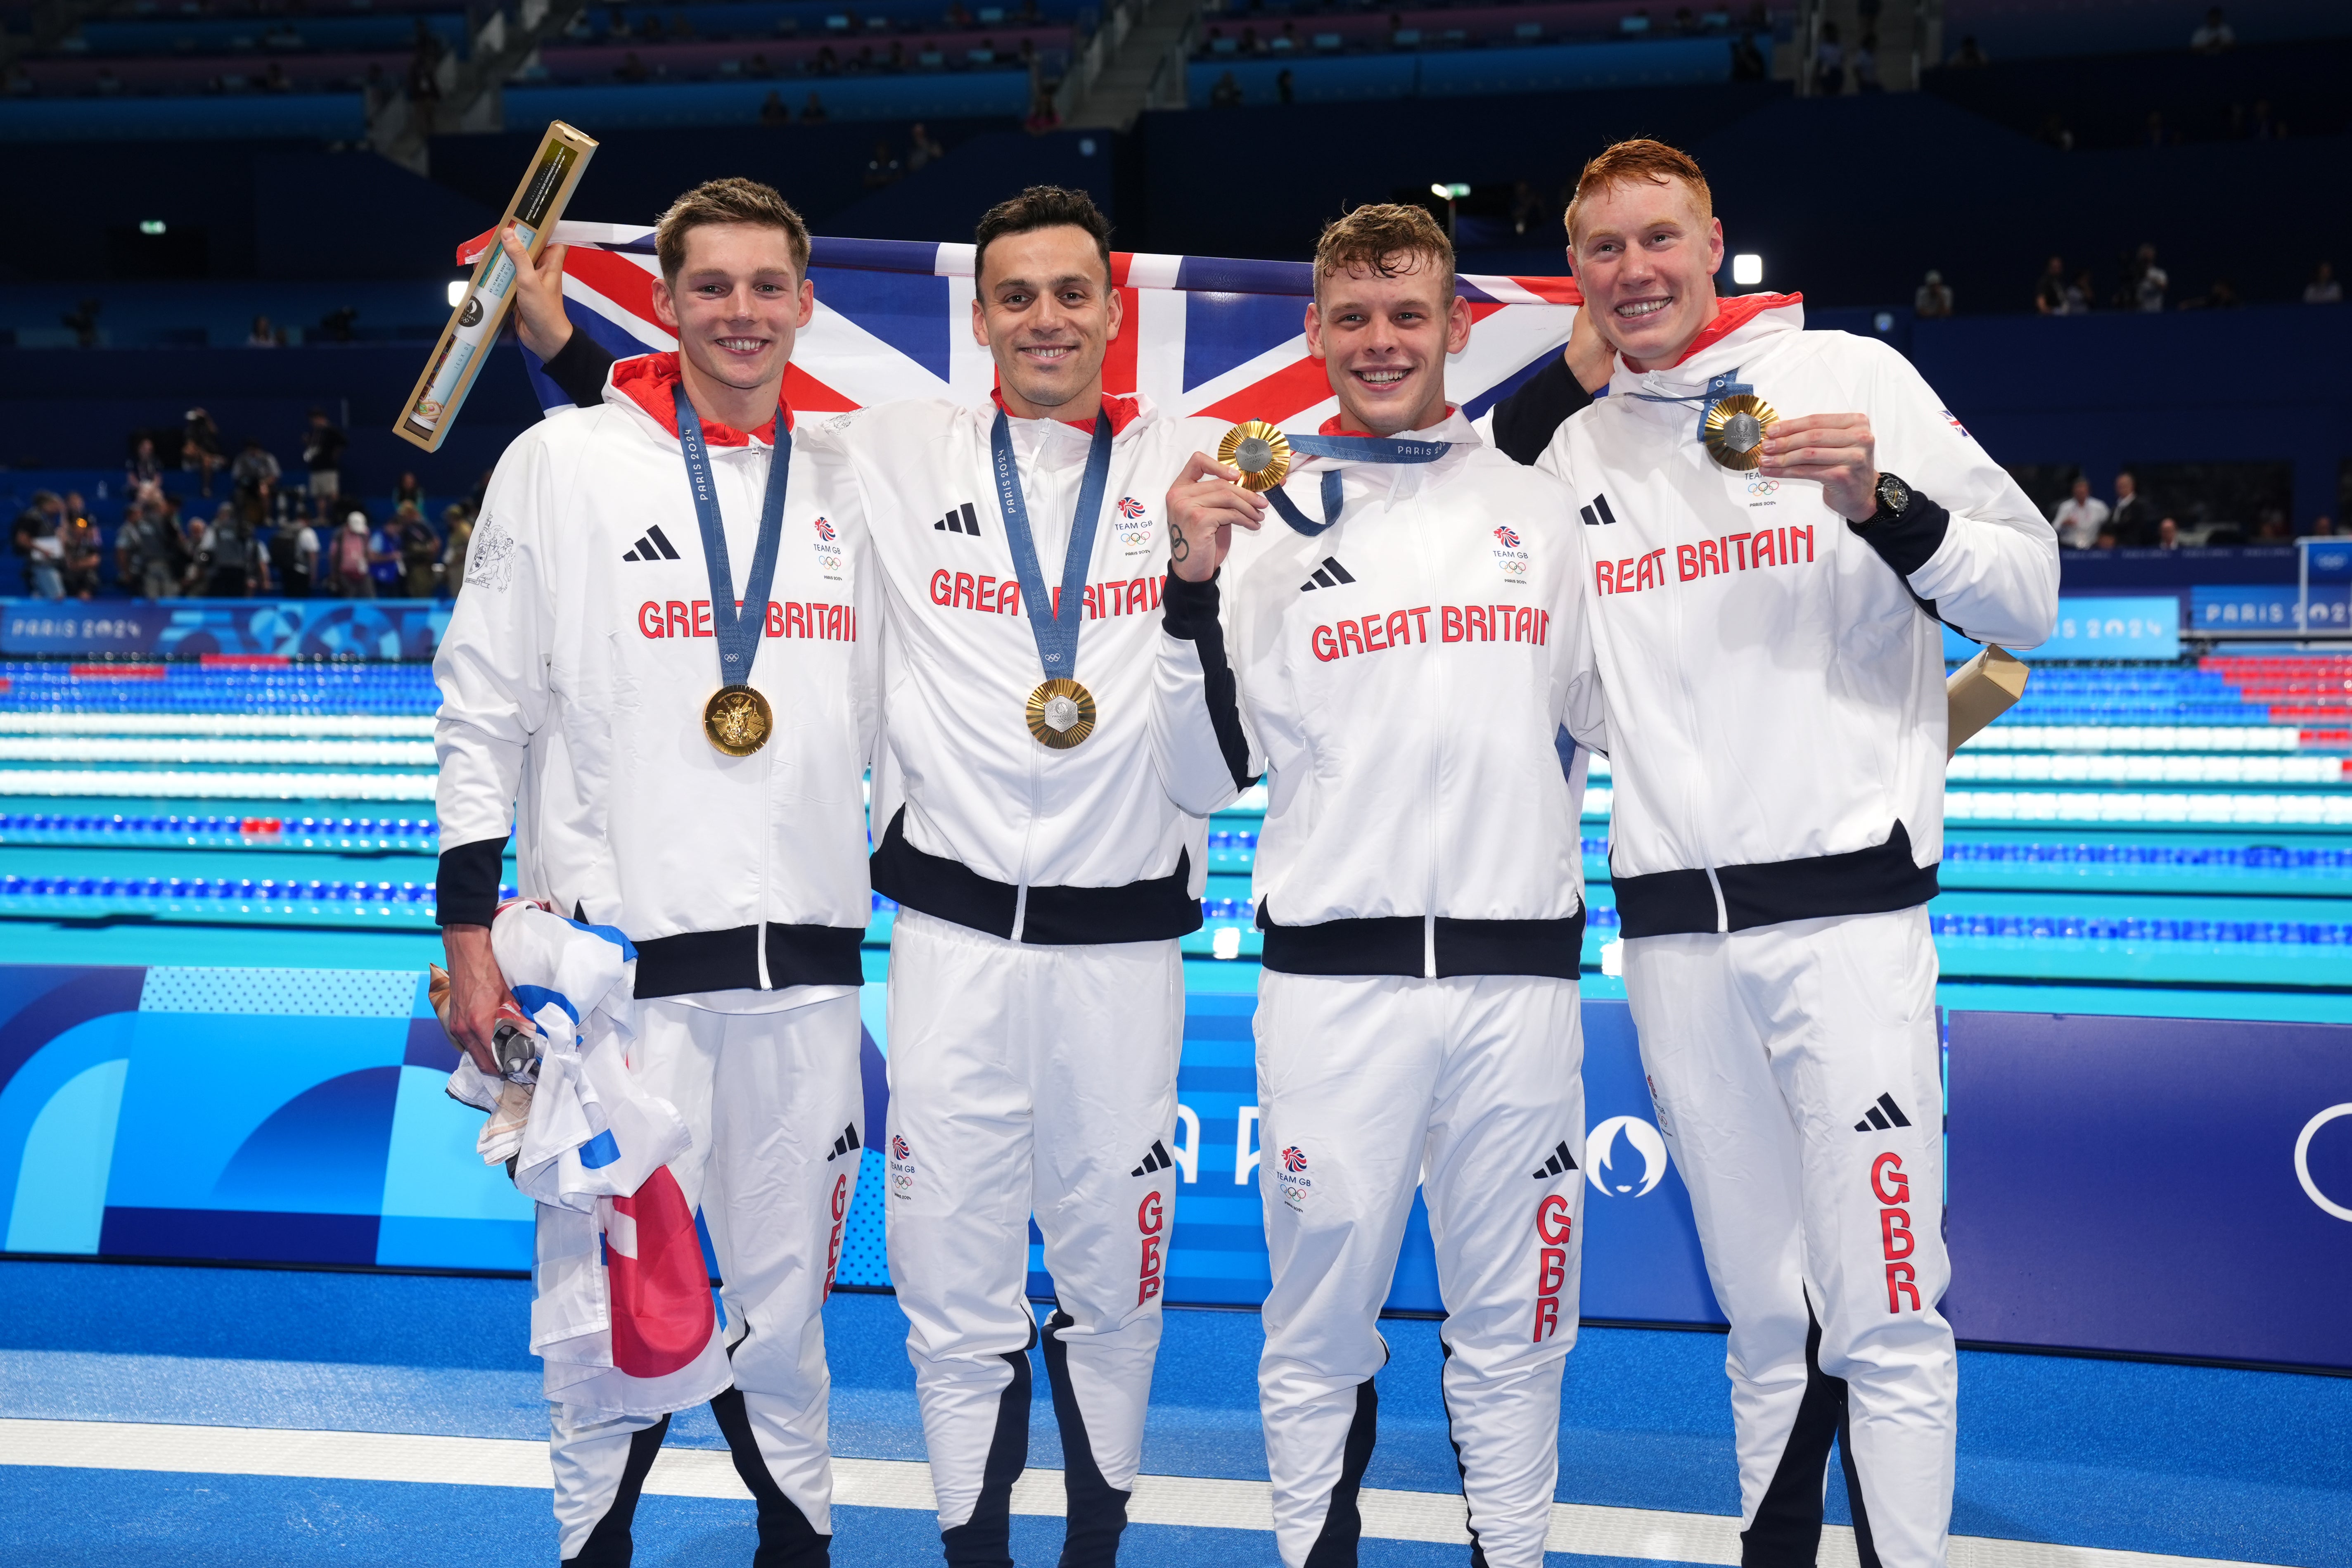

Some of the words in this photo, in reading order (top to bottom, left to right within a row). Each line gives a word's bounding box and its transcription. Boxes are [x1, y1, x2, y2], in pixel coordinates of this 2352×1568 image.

[493, 263, 513, 296] LYMPIADE
[454, 354, 465, 369] JEUX
[684, 429, 699, 460] 2024
[997, 449, 1009, 478] 2024
[813, 544, 831, 553] TEAM
[1596, 548, 1666, 596] REAT
[1676, 525, 1814, 582] BRITAIN
[930, 569, 1021, 616] GREA
[638, 600, 744, 639] GRE
[1312, 606, 1431, 662] GREAT
[2086, 618, 2162, 639] 2024
[890, 1160, 903, 1172] TEAM
[1276, 1171, 1296, 1184] TEAM
[1299, 1178, 1311, 1186] GB
[1871, 1152, 1920, 1314] GBR
[1533, 1195, 1571, 1343] GBR
